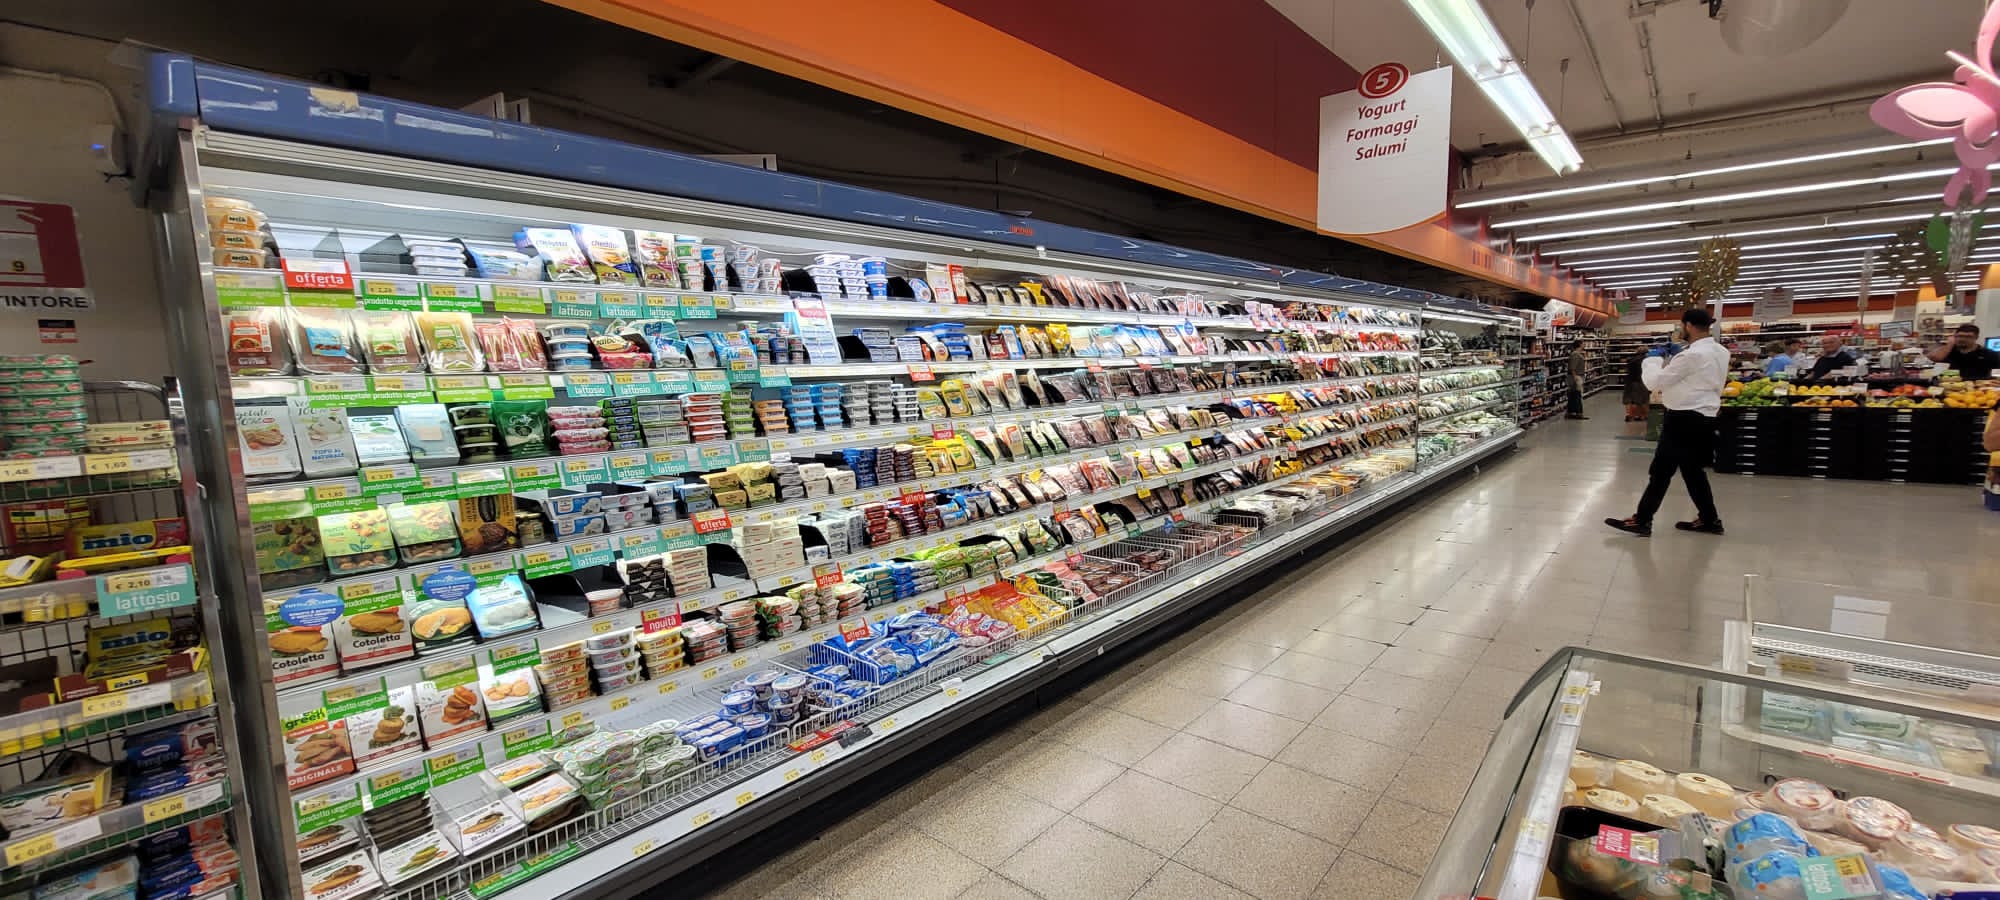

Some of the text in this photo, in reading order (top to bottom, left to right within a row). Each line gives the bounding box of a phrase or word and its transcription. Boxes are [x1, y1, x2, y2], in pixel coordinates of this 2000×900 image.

[1374, 71, 1391, 90] 5
[1358, 98, 1406, 121] Yogurt
[1346, 114, 1419, 143] Formaggi
[1355, 138, 1408, 161] Salumi
[12, 260, 25, 272] 9
[295, 273, 344, 285] offerta
[559, 307, 592, 317] lattosio
[606, 307, 637, 317] lattosio
[686, 308, 711, 316] lattosio
[574, 385, 605, 394] lattosio
[621, 384, 650, 394] lattosio
[700, 382, 726, 391] lattosio
[373, 392, 402, 400] prodotto
[617, 469, 645, 479] lattosio
[658, 463, 686, 473] lattosio
[571, 472, 602, 483] lattosio
[312, 501, 346, 511] prodotto
[700, 519, 727, 531] offerta
[82, 532, 154, 551] mio
[667, 539, 694, 551] lattosio
[628, 544, 656, 555] lattosio
[577, 555, 609, 567] lattosio
[819, 575, 839, 585] offerta
[115, 589, 181, 610] lattosio
[648, 617, 677, 631] novità
[100, 630, 168, 651] mio
[352, 633, 401, 649] Cotoletta
[272, 653, 325, 671] Cotoletta
[285, 710, 326, 731] green
[372, 786, 401, 802] prodotto
[298, 811, 330, 827] prodotto
[1807, 863, 1832, 894] lattosio
